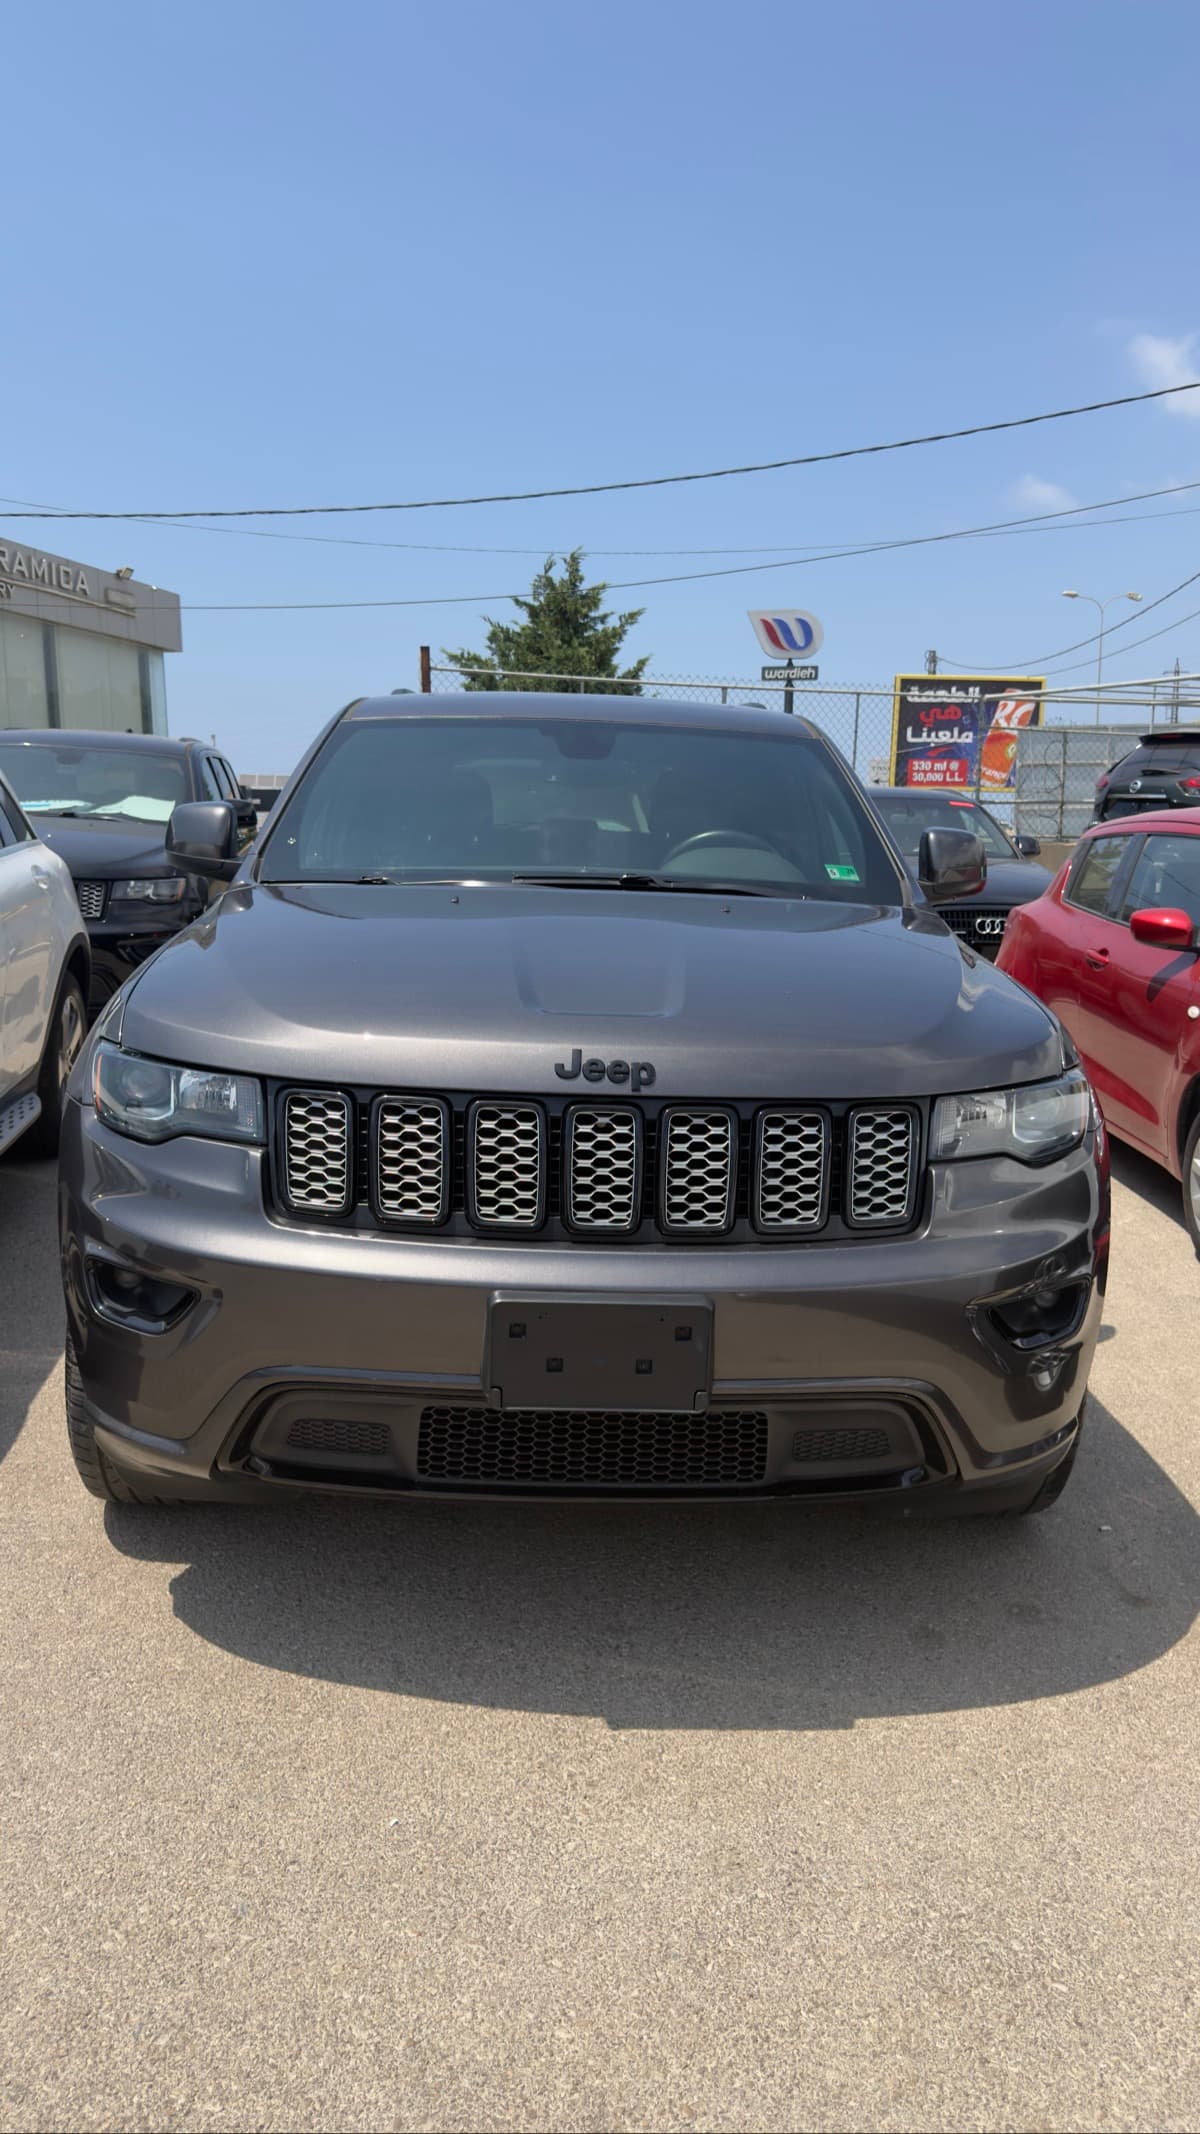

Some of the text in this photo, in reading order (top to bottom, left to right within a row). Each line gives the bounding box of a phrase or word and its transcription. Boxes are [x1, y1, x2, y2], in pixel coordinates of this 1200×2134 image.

[764, 667, 816, 679] wardieh
[919, 704, 962, 728] هي
[991, 699, 1036, 728] RC
[906, 725, 974, 747] ملعبنا
[912, 760, 932, 771] 330
[912, 772, 944, 783] 30,000
[554, 1048, 656, 1092] Jeep
